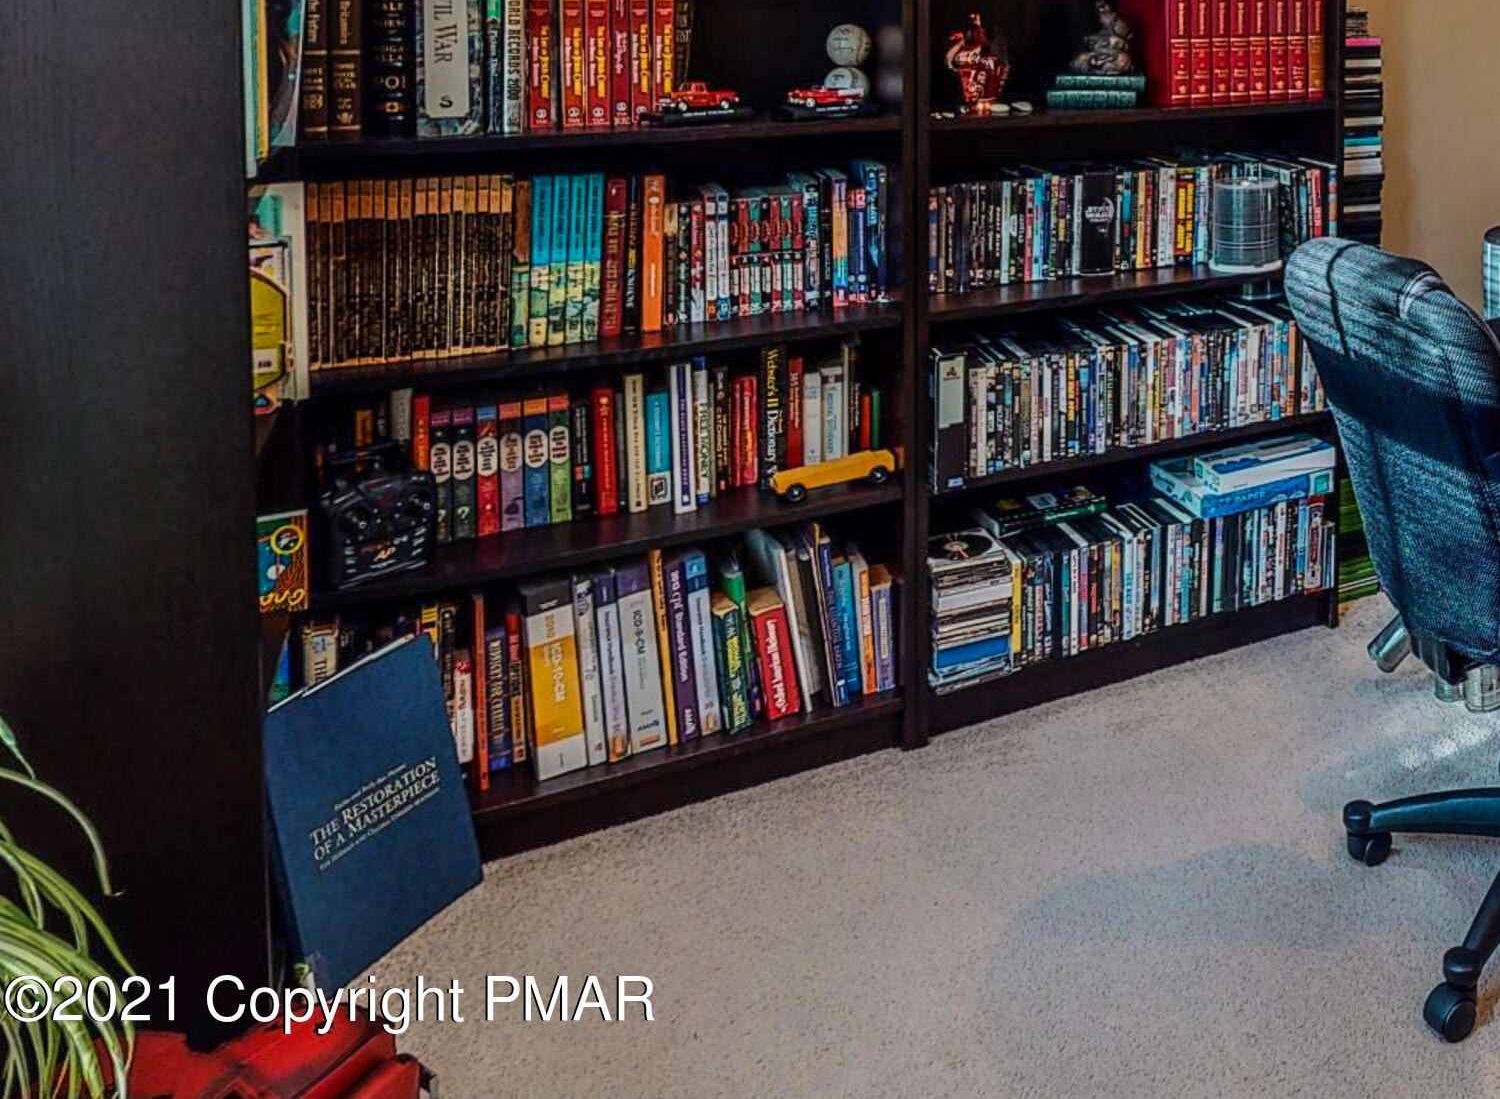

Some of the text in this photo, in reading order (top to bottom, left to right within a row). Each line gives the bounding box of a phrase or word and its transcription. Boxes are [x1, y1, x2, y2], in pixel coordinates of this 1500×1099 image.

[508, 28, 522, 75] RECORDS
[766, 348, 781, 397] Webster's
[764, 409, 780, 463] Dictionary
[679, 651, 689, 683] Edition
[309, 817, 340, 845] THE
[341, 756, 438, 824] RESTORATION
[312, 839, 333, 862] OF
[335, 832, 346, 847] A
[347, 769, 440, 838] MASTERPIECE
